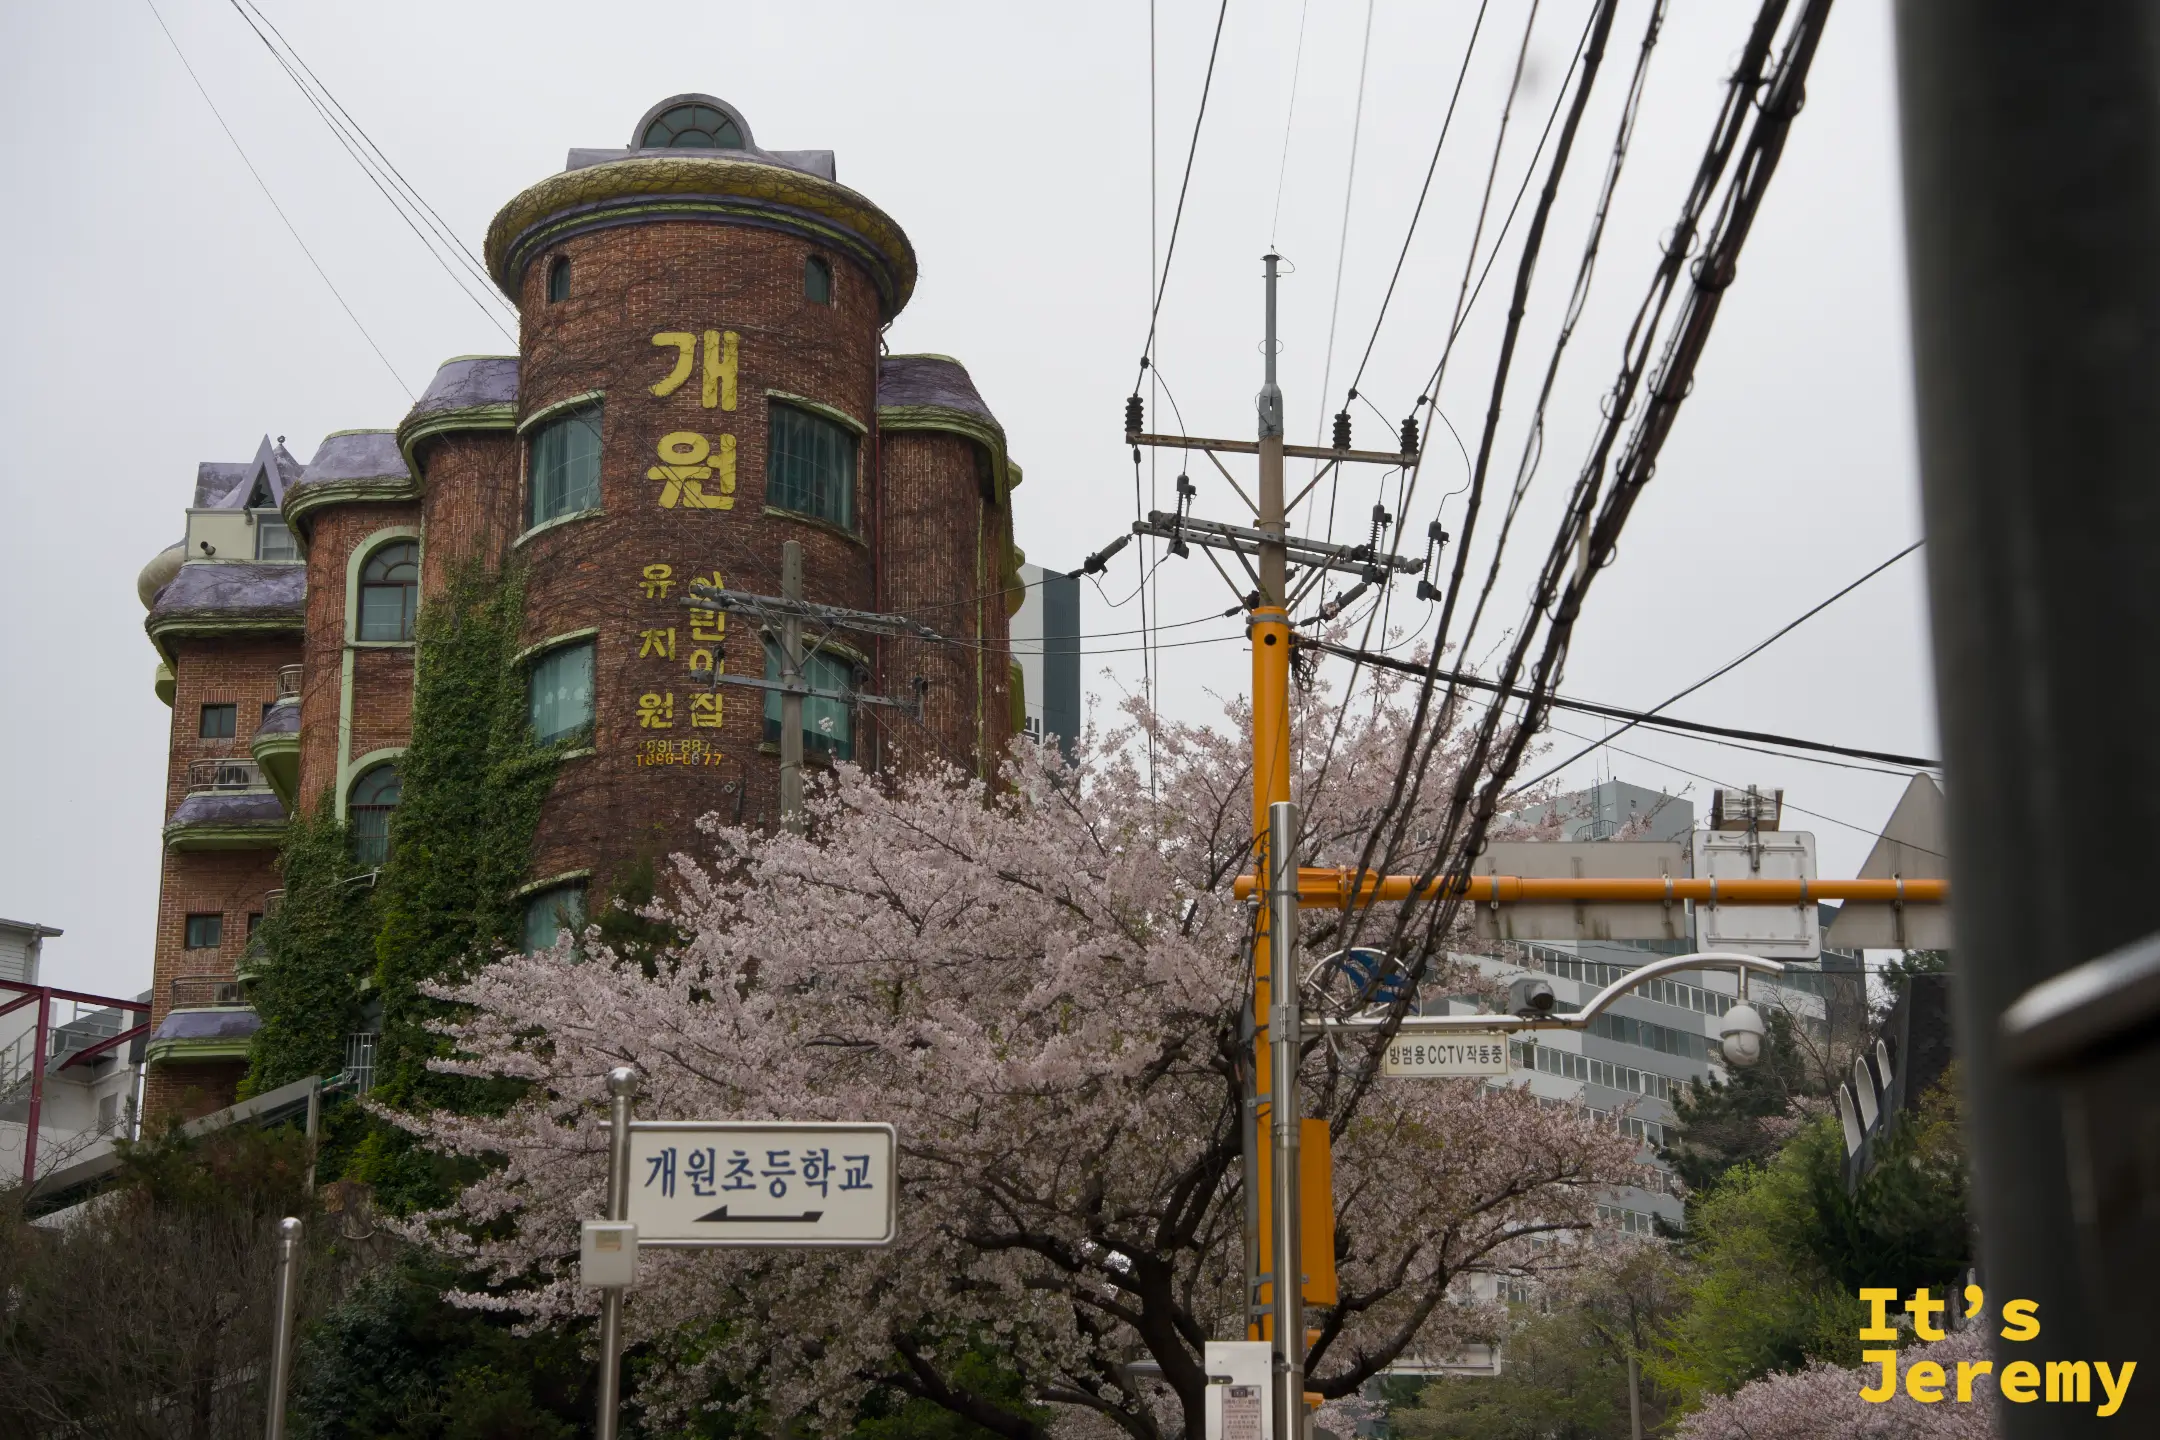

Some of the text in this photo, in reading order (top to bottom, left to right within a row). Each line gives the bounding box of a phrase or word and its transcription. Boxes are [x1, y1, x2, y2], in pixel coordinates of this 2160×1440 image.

[647, 329, 739, 511] 개원
[635, 563, 677, 729] 유치원
[643, 1146, 874, 1200] 개원초등학교
